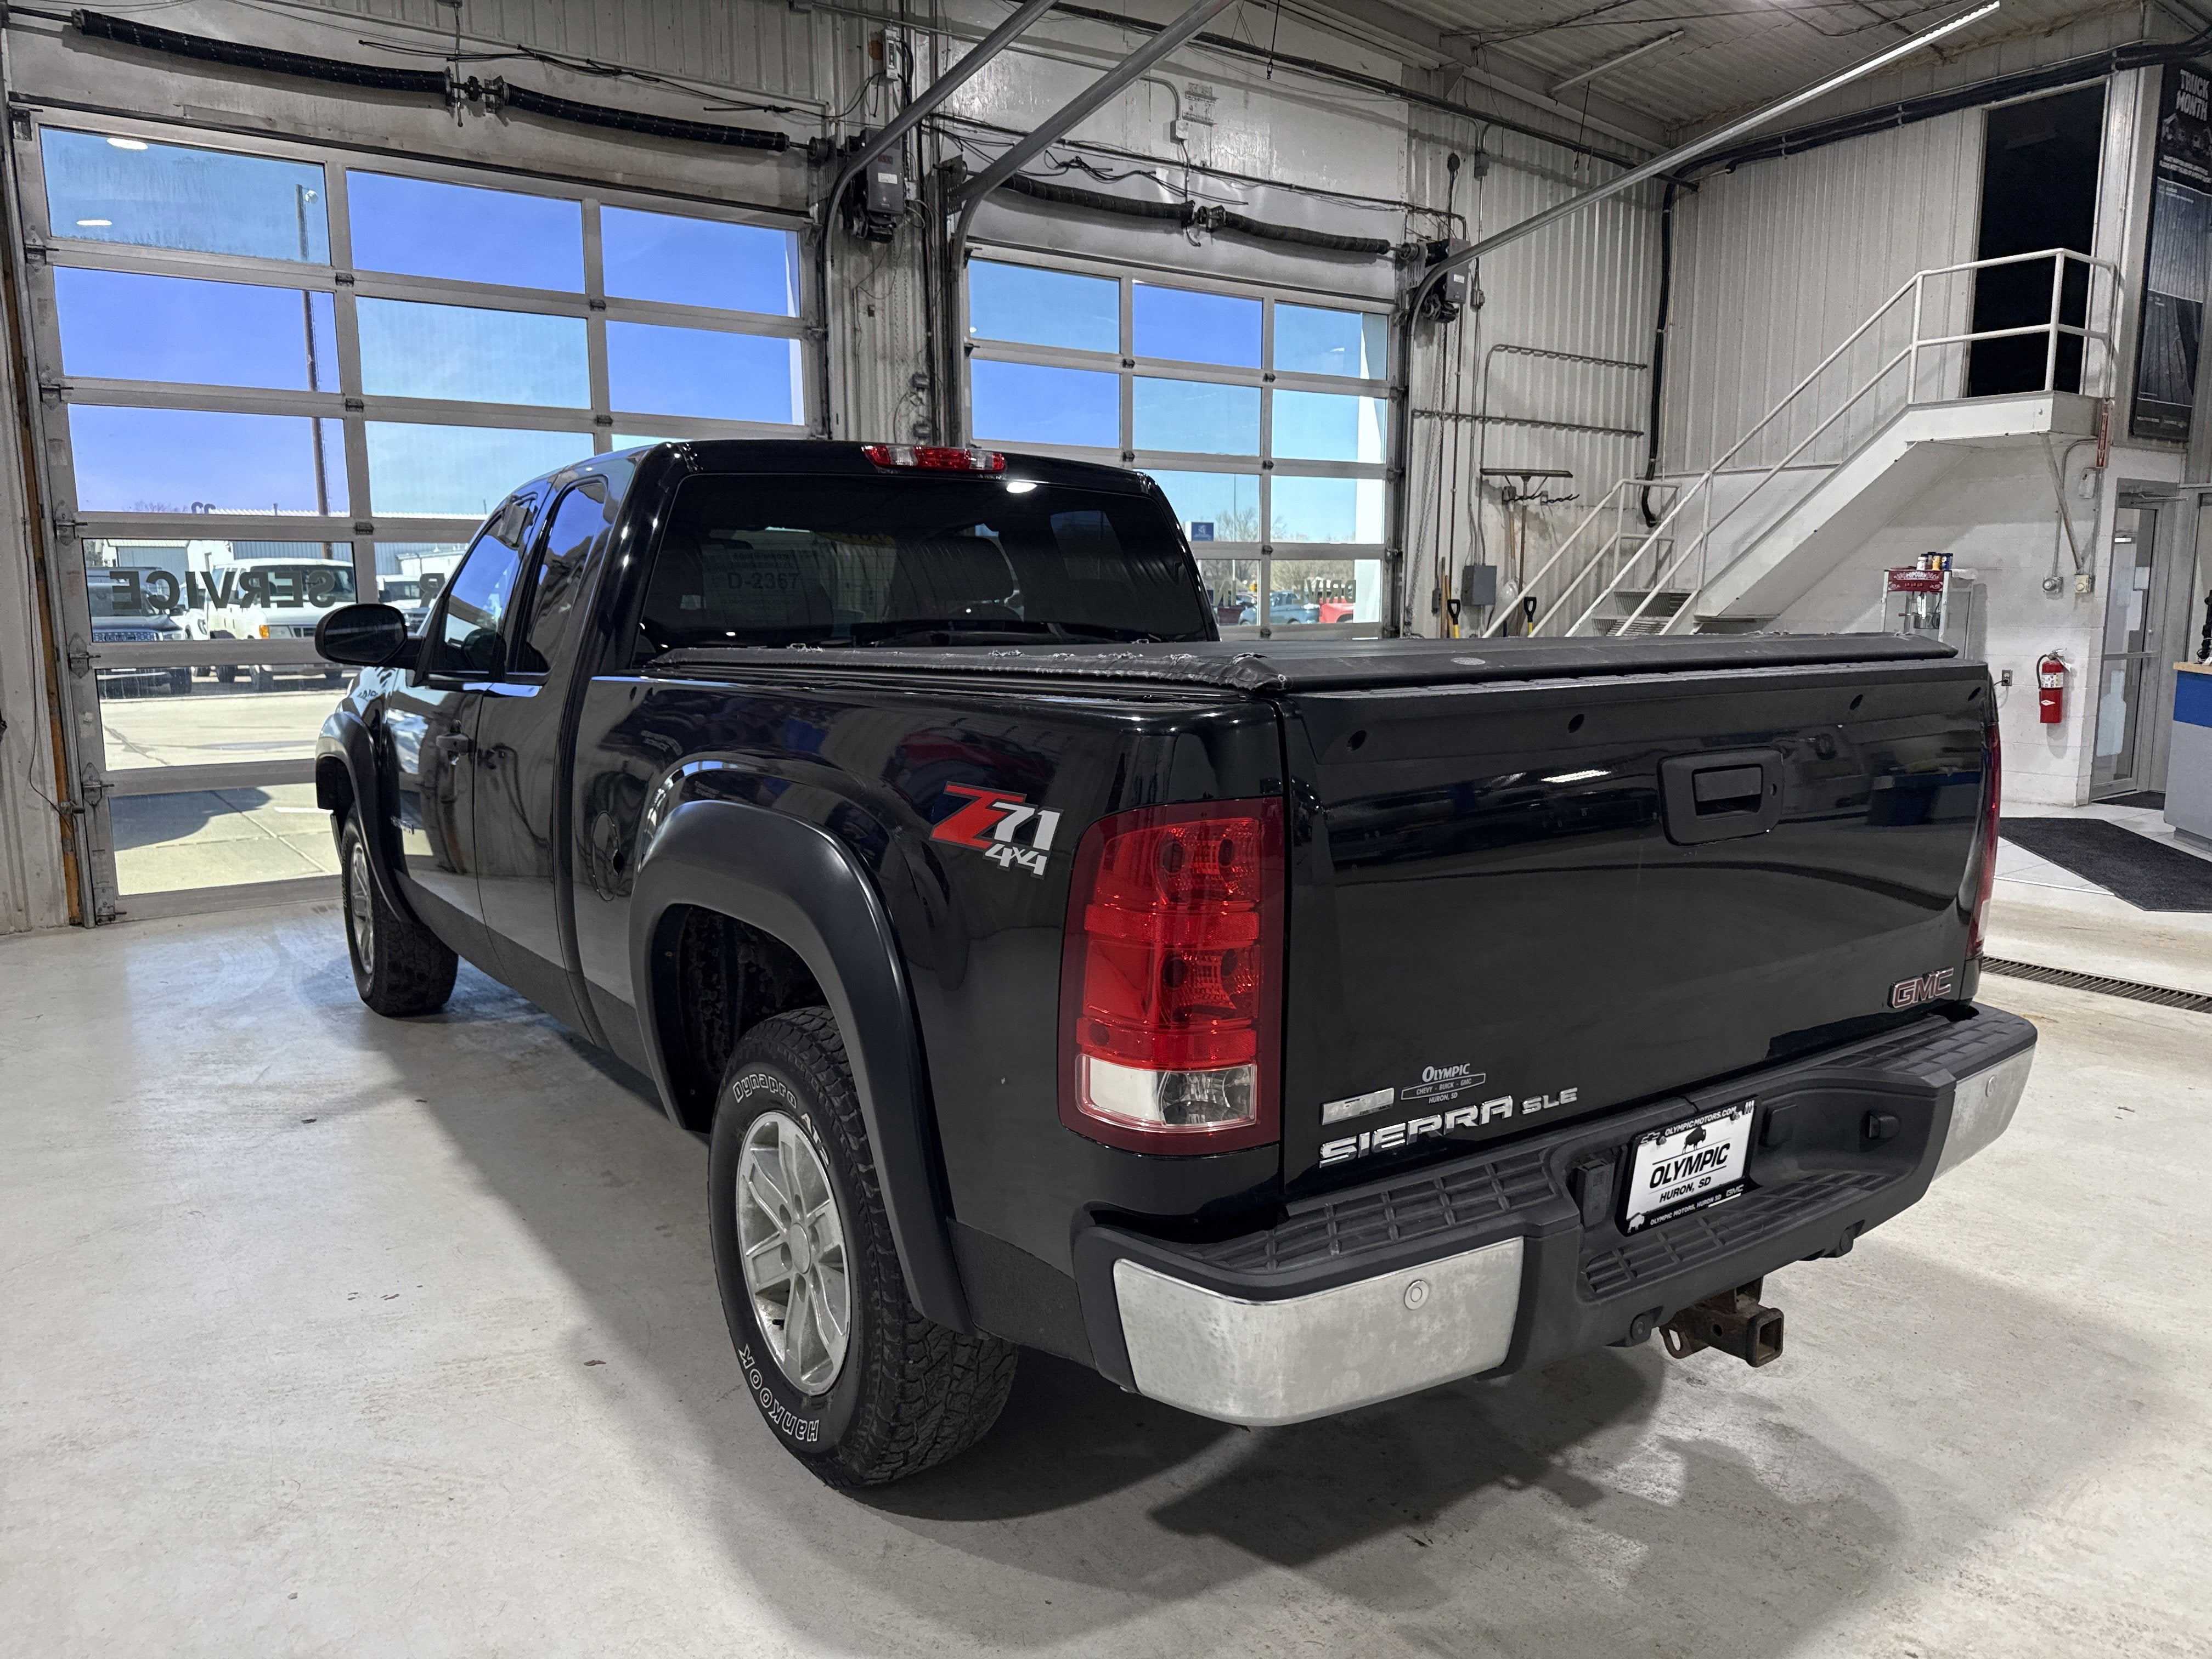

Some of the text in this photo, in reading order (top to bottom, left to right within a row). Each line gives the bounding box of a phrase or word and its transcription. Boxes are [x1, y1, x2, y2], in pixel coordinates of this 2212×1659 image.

[2180, 69, 2210, 100] TRUCK
[2175, 89, 2208, 121] MONTH
[727, 572, 800, 590] D-2367
[931, 784, 1060, 851] Z71
[1892, 967, 1954, 1008] GMC
[1416, 1086, 1433, 1096] CHEVY
[1439, 1082, 1454, 1091] BUICK
[1460, 1078, 1472, 1086] GMC
[1422, 1063, 1470, 1082] OLYMPIC
[732, 1073, 797, 1109] Dynapro
[1429, 1095, 1450, 1104] HURON,
[1319, 1087, 1578, 1169] SIERRA SLE
[1649, 1143, 1731, 1189] OLYMPIC
[1659, 1176, 1711, 1203] HURON, SD
[1725, 1184, 1744, 1197] GMC
[1650, 1212, 1673, 1226] OLYMPIC
[1696, 1197, 1714, 1208] HURON
